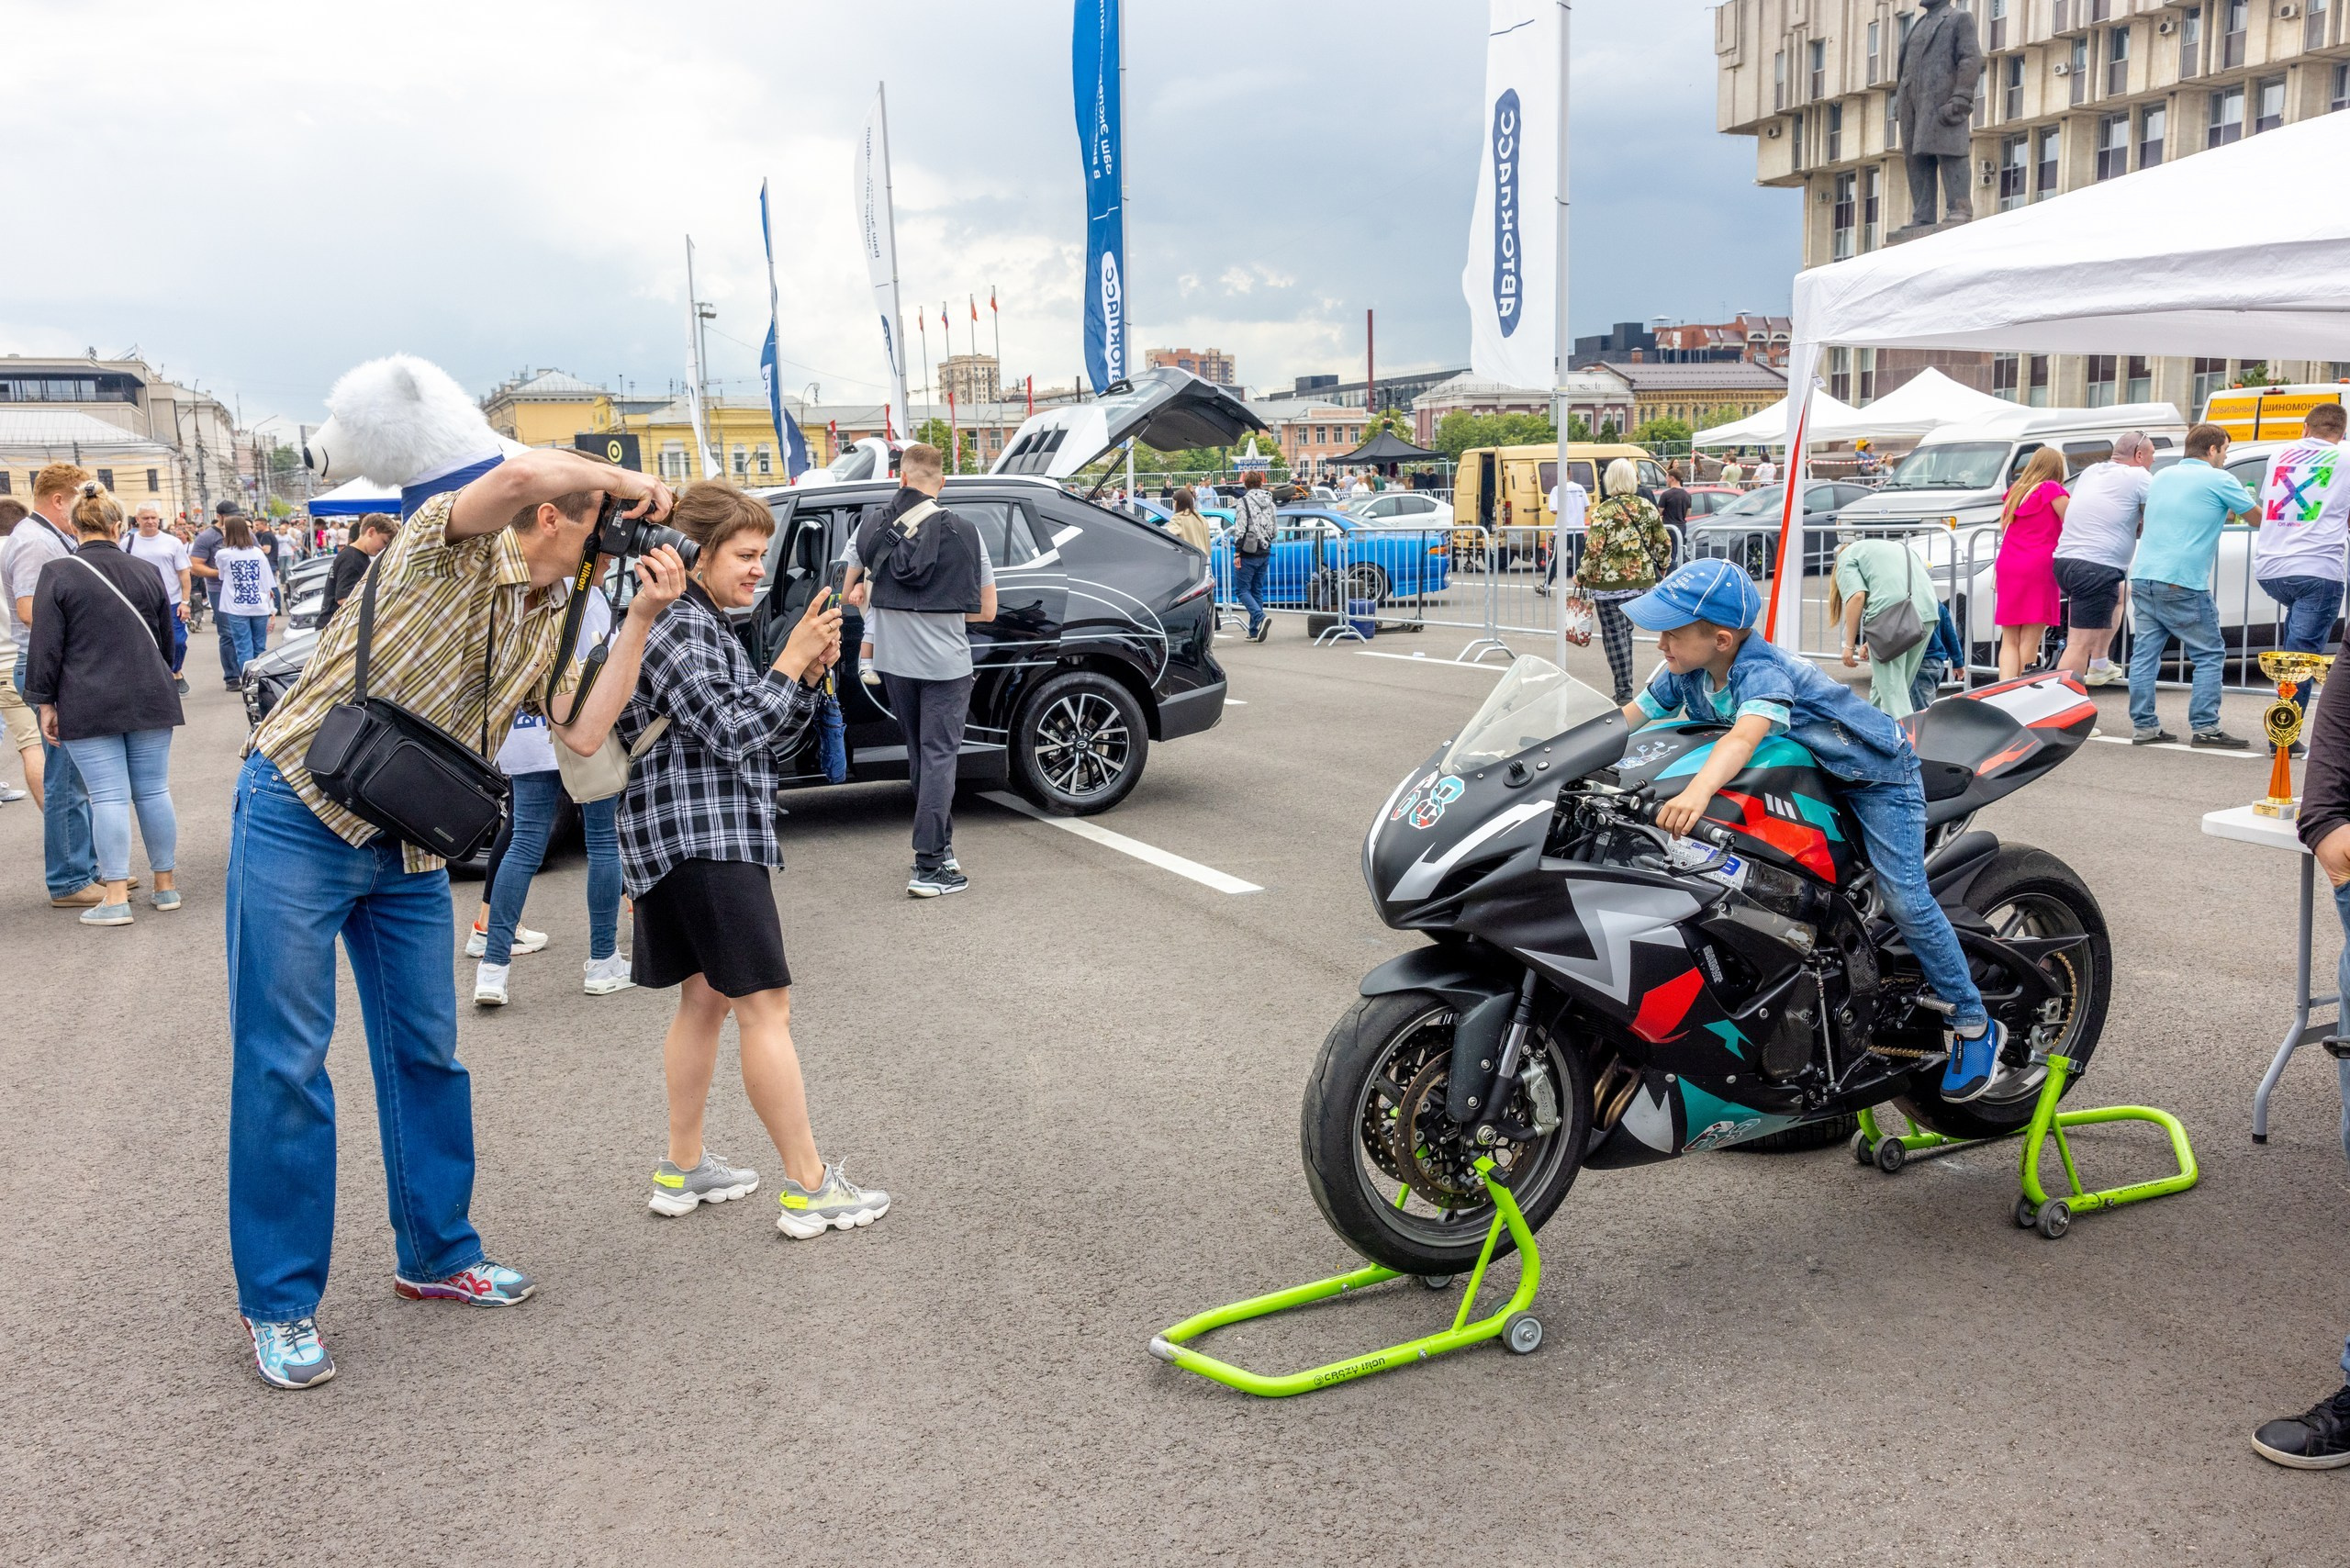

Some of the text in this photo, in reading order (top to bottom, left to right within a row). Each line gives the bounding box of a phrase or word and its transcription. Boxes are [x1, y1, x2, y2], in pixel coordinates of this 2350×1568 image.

[2263, 402, 2321, 412] ШИНОМОН
[576, 561, 593, 591] Nikon
[1390, 770, 1466, 830] 68
